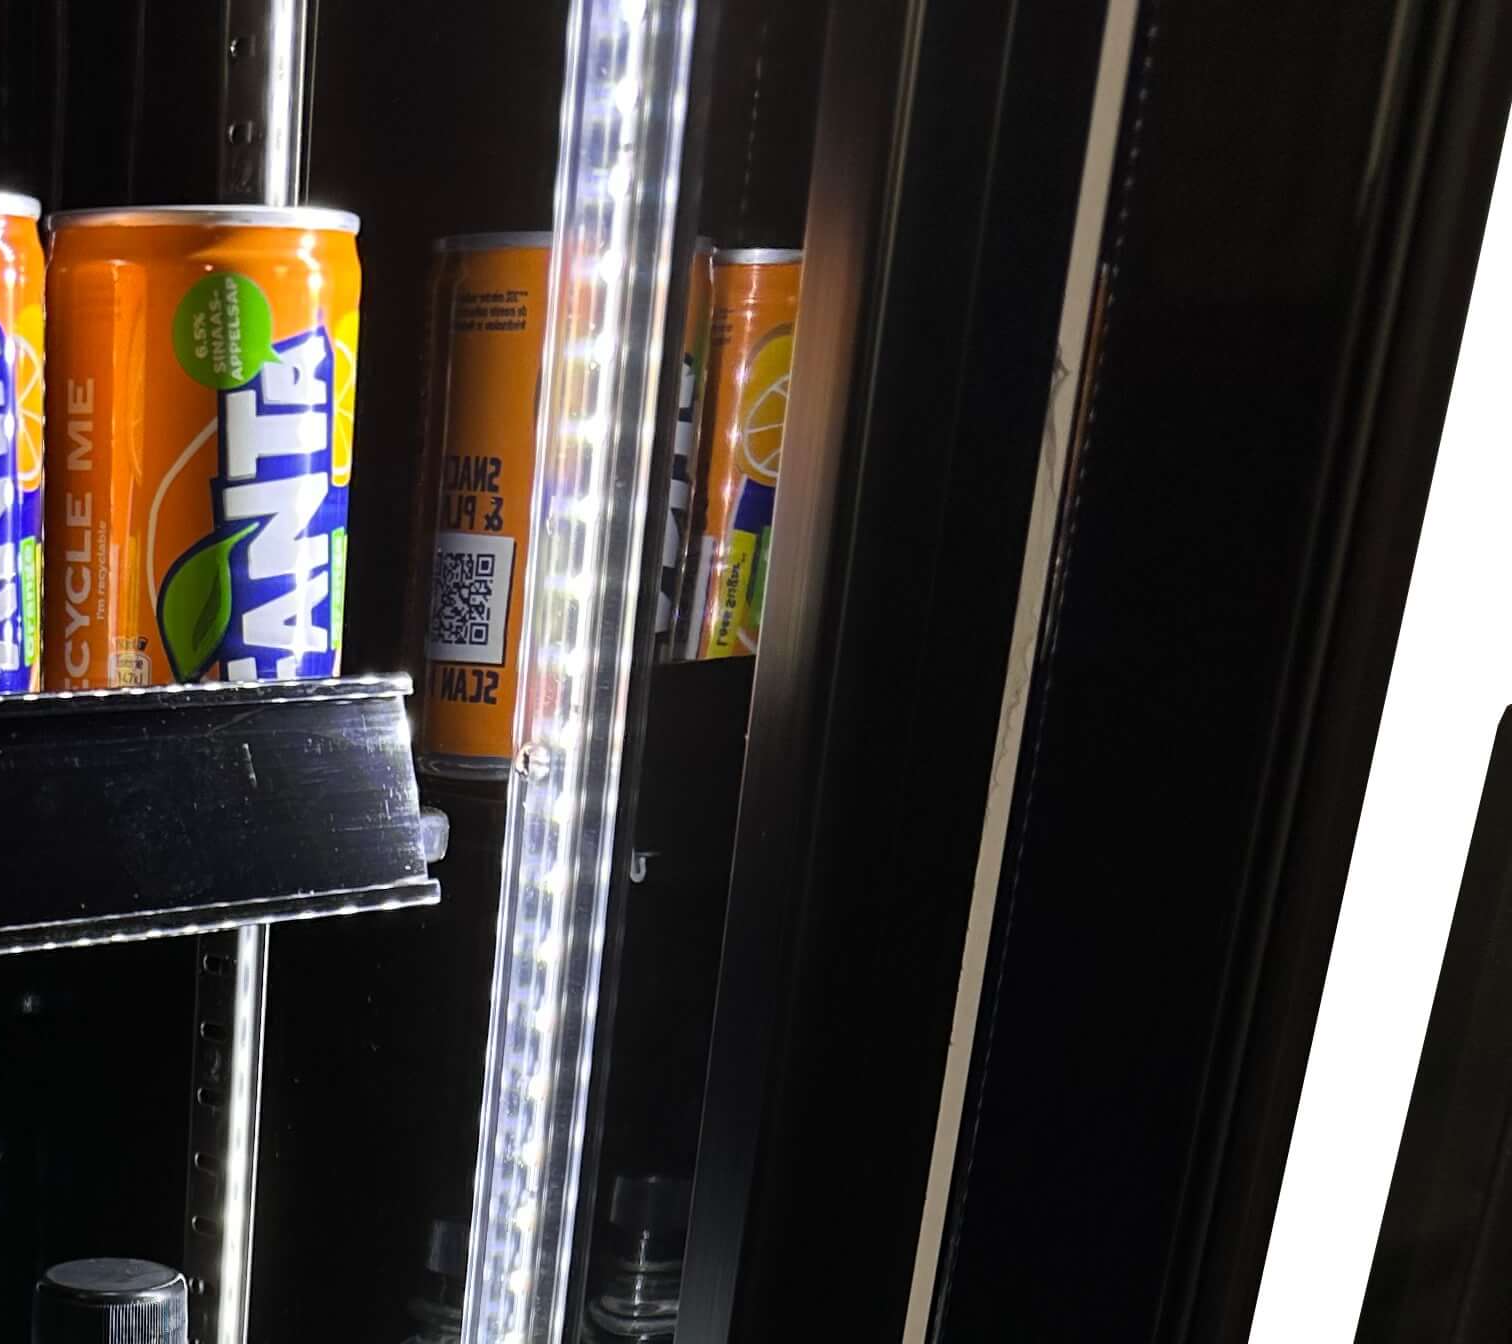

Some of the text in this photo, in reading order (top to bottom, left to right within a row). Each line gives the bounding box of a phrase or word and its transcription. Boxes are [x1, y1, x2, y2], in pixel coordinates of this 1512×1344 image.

[194, 311, 207, 360] 6.5%
[213, 290, 228, 375] SINAAS-
[226, 275, 245, 382] APPELSAP
[67, 377, 94, 471] ME
[222, 335, 330, 682] ANTA
